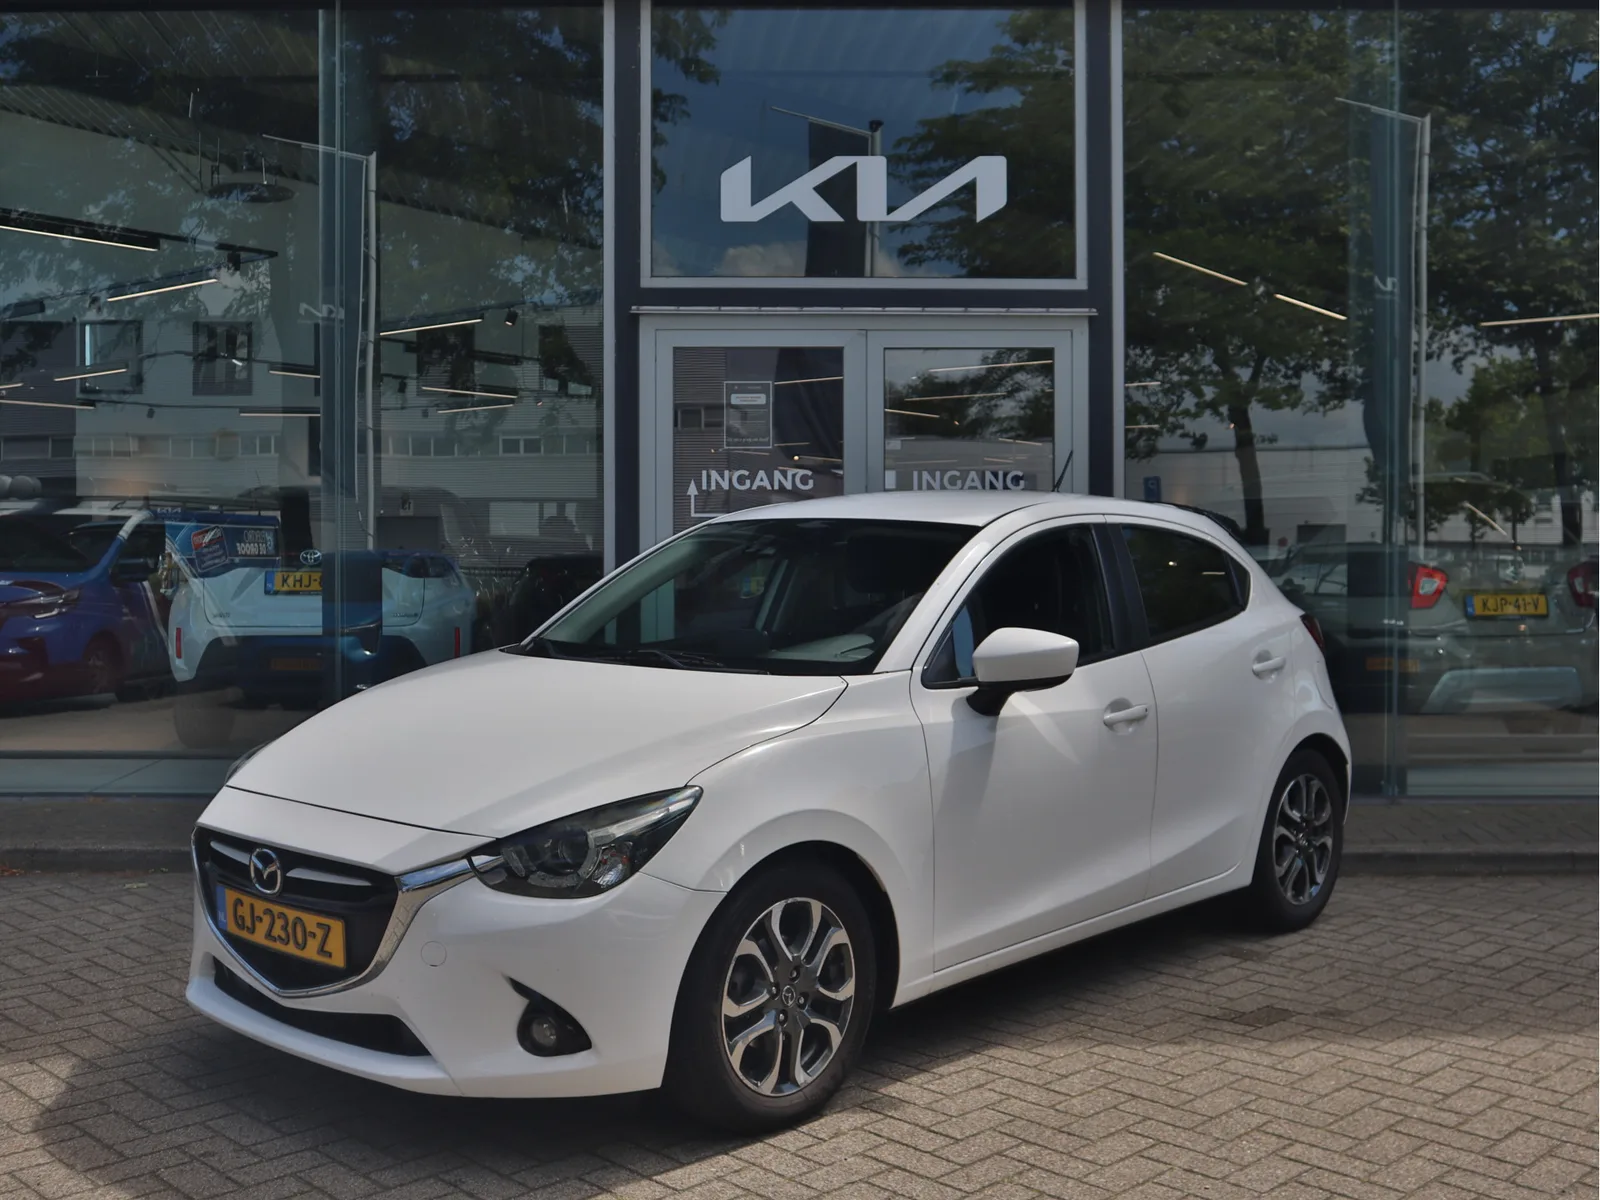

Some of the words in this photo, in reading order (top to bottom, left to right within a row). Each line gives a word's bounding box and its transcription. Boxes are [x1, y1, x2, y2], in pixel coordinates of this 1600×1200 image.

[720, 155, 1007, 223] KIA
[701, 469, 814, 491] INGANG
[912, 470, 1026, 491] INGANG
[1481, 596, 1541, 613] KJP-41-V
[232, 897, 333, 959] GJ-230-Z
